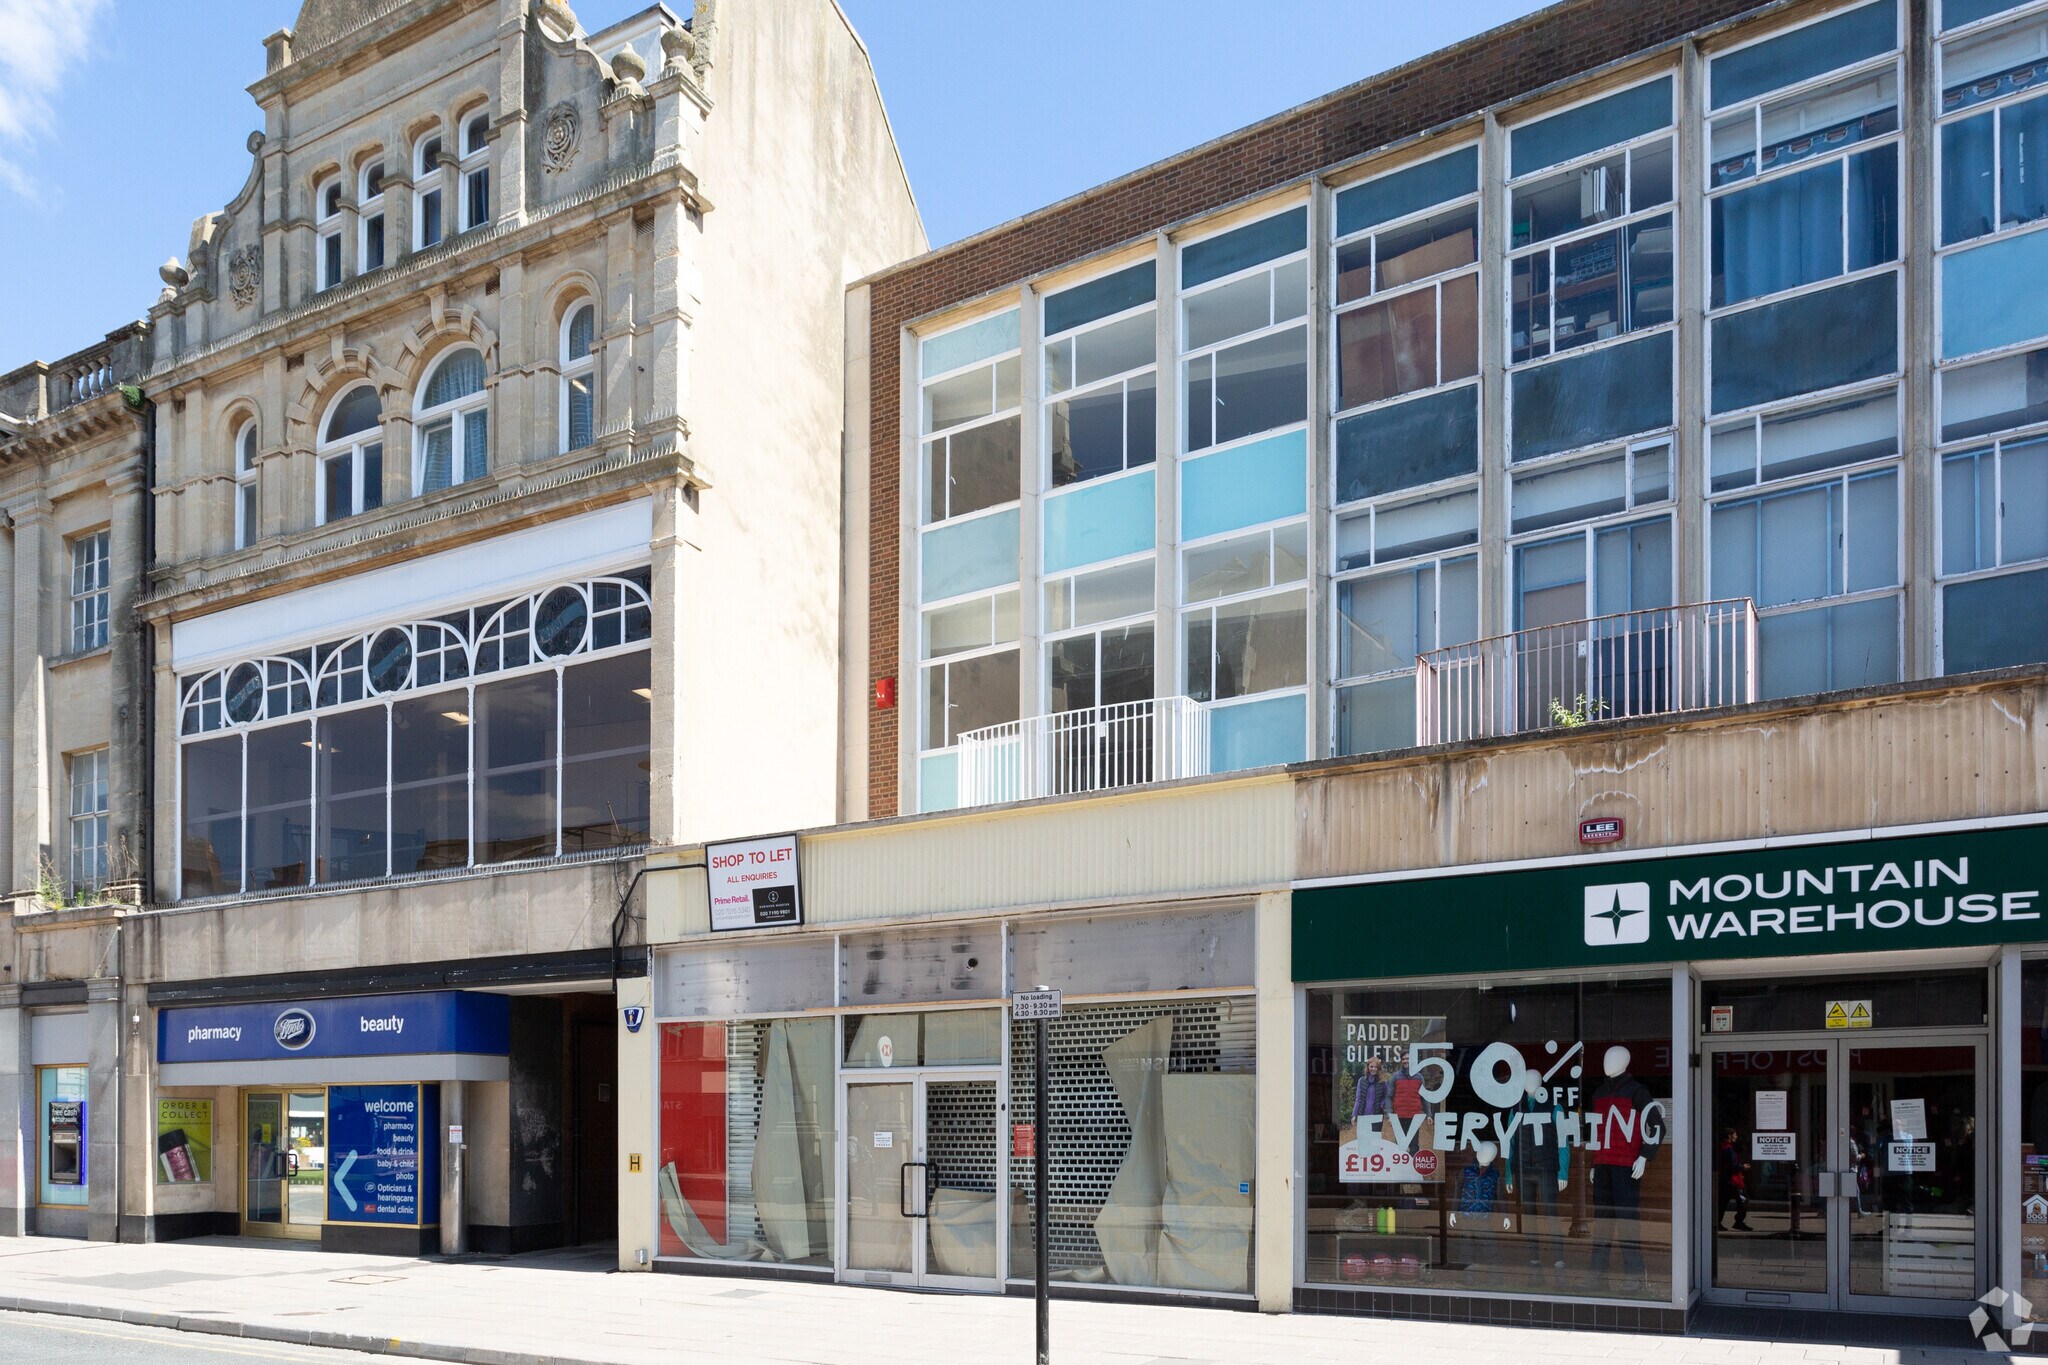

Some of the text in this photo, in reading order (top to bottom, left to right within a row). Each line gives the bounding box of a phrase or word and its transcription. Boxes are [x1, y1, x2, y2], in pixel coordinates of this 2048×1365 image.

[1586, 823, 1615, 833] LEE
[712, 848, 792, 868] SHOP TO LET
[741, 872, 778, 882] ENQUIRIES
[1669, 856, 1969, 906] MOUNTAIN
[714, 897, 731, 905] Prime
[1666, 890, 2041, 941] WAREHOUSE
[277, 1017, 305, 1041] Boots
[360, 1015, 404, 1034] beauty
[188, 1025, 242, 1043] pharmacy
[1346, 1023, 1410, 1042] PADDED
[1346, 1044, 1402, 1063] GILETS
[1408, 1040, 1584, 1109] 50%
[1535, 1086, 1579, 1107] OFF
[162, 1101, 208, 1110] ORDER &
[365, 1098, 414, 1113] welcome
[64, 1108, 78, 1117] cash
[161, 1111, 208, 1119] COLLECT
[383, 1121, 414, 1131] pharmacy
[1356, 1100, 1666, 1159] EVERYTHING
[392, 1133, 414, 1143] beauty
[376, 1147, 414, 1156] food & drink
[377, 1160, 414, 1169] baby & child
[395, 1172, 414, 1181] photo
[377, 1183, 406, 1192] Opticians
[407, 1184, 413, 1193] &
[378, 1194, 414, 1203] hearingcare
[377, 1203, 397, 1213] dental
[398, 1205, 414, 1214] clinic
